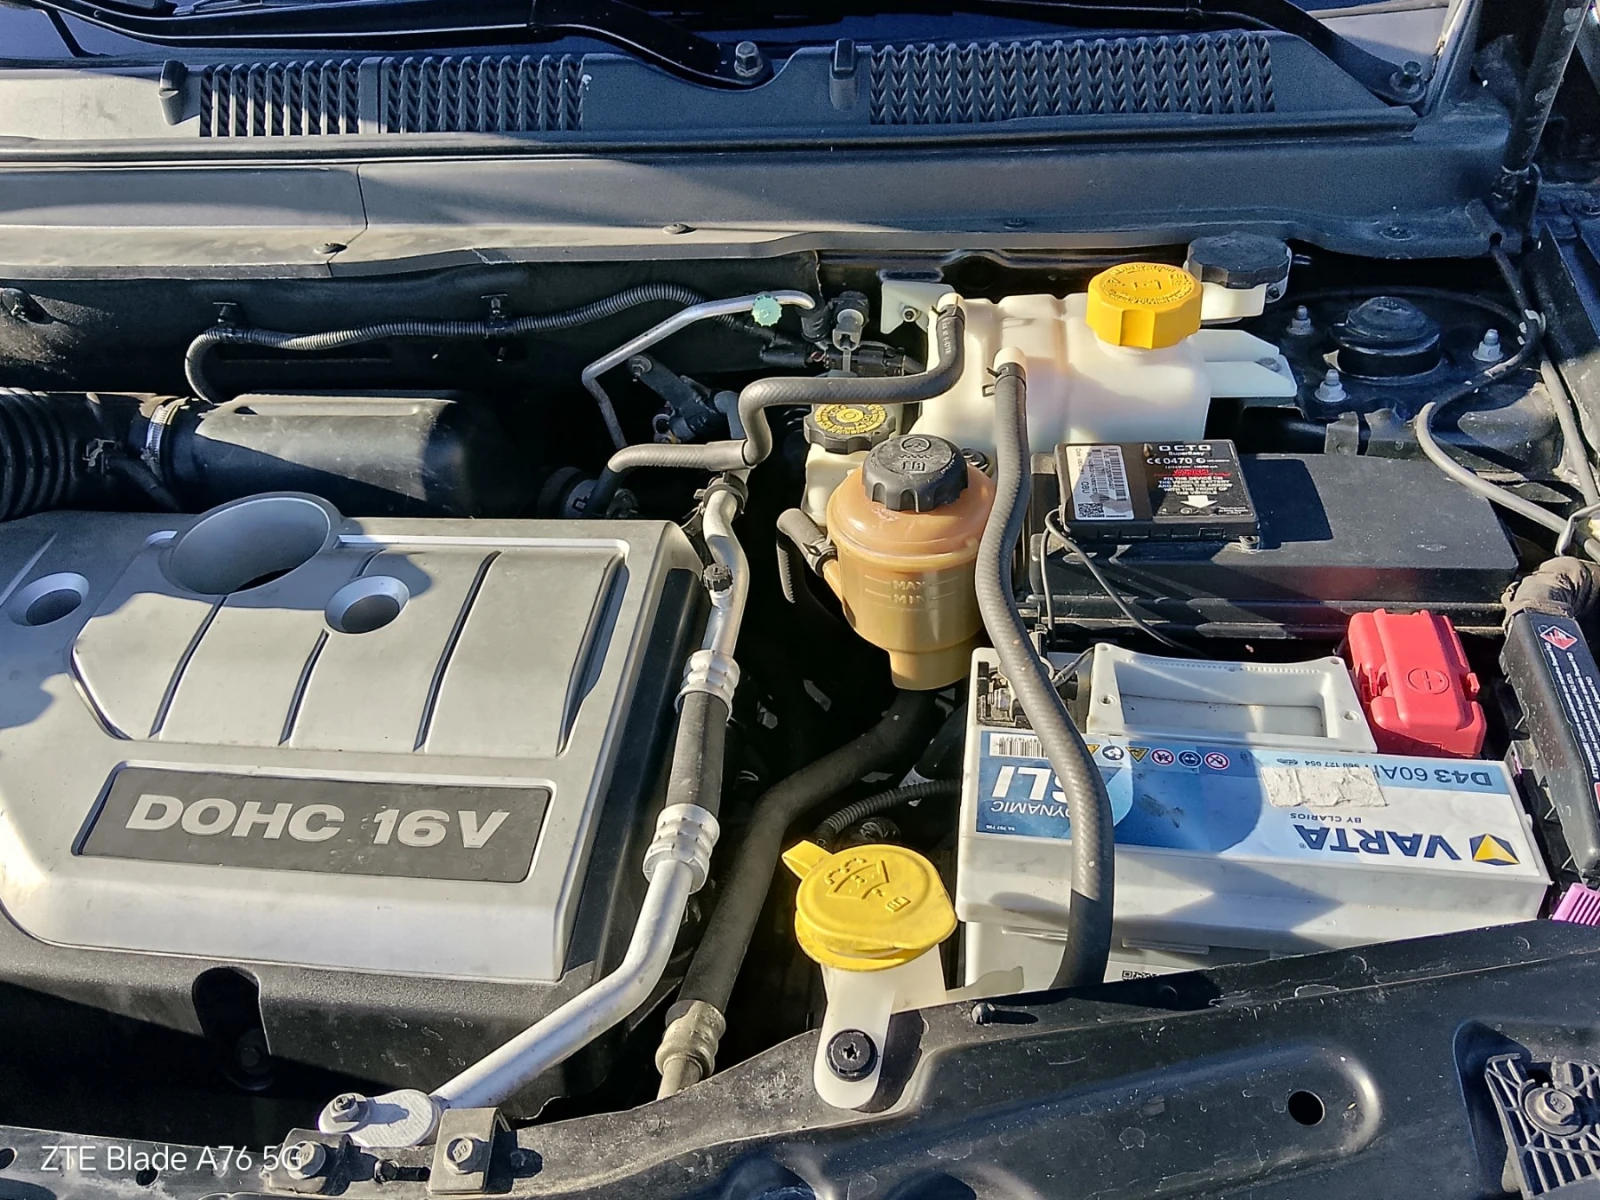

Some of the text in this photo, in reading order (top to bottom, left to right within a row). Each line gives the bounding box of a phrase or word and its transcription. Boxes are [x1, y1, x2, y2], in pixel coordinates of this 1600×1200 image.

[1159, 444, 1211, 452] OCTO
[893, 580, 926, 590] MAX
[1436, 769, 1493, 787] D43
[125, 793, 511, 849] DOHC 16V
[1290, 812, 1342, 822] CLARIOS
[1293, 824, 1462, 860] VARTA
